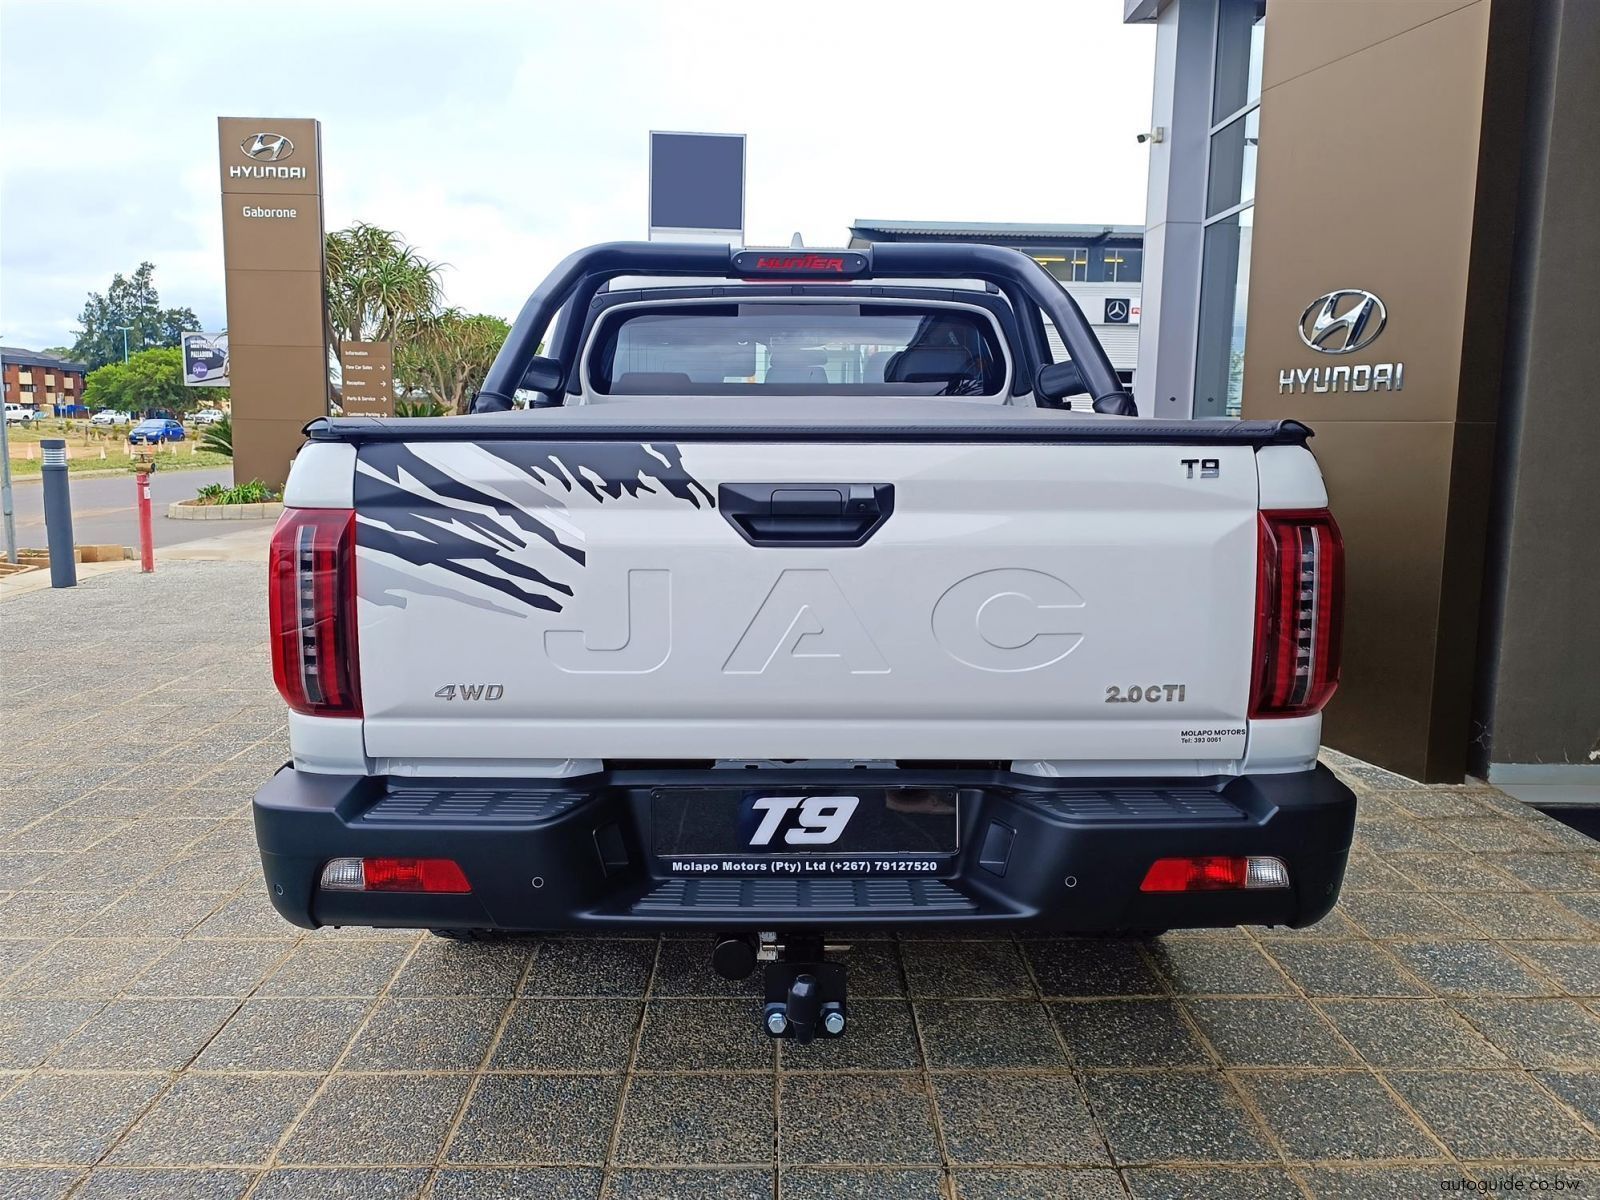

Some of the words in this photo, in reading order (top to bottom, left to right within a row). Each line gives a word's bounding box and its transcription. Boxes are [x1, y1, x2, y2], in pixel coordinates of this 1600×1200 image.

[230, 165, 306, 179] HYUNDAI
[242, 206, 297, 218] Gaborone
[757, 254, 844, 272] HUNTER
[1279, 362, 1404, 395] HYUNDAI
[1180, 458, 1220, 479] T9
[543, 567, 1086, 674] JAC
[434, 683, 504, 701] 4WD
[1104, 684, 1186, 703] 2.0CTI
[749, 796, 860, 846] T9
[672, 861, 719, 873] Molapo
[722, 861, 767, 871] Motors
[771, 861, 801, 873] (Pty)
[805, 861, 826, 871] Ltd
[830, 861, 871, 873] (+267)
[874, 861, 938, 871] 79127520
